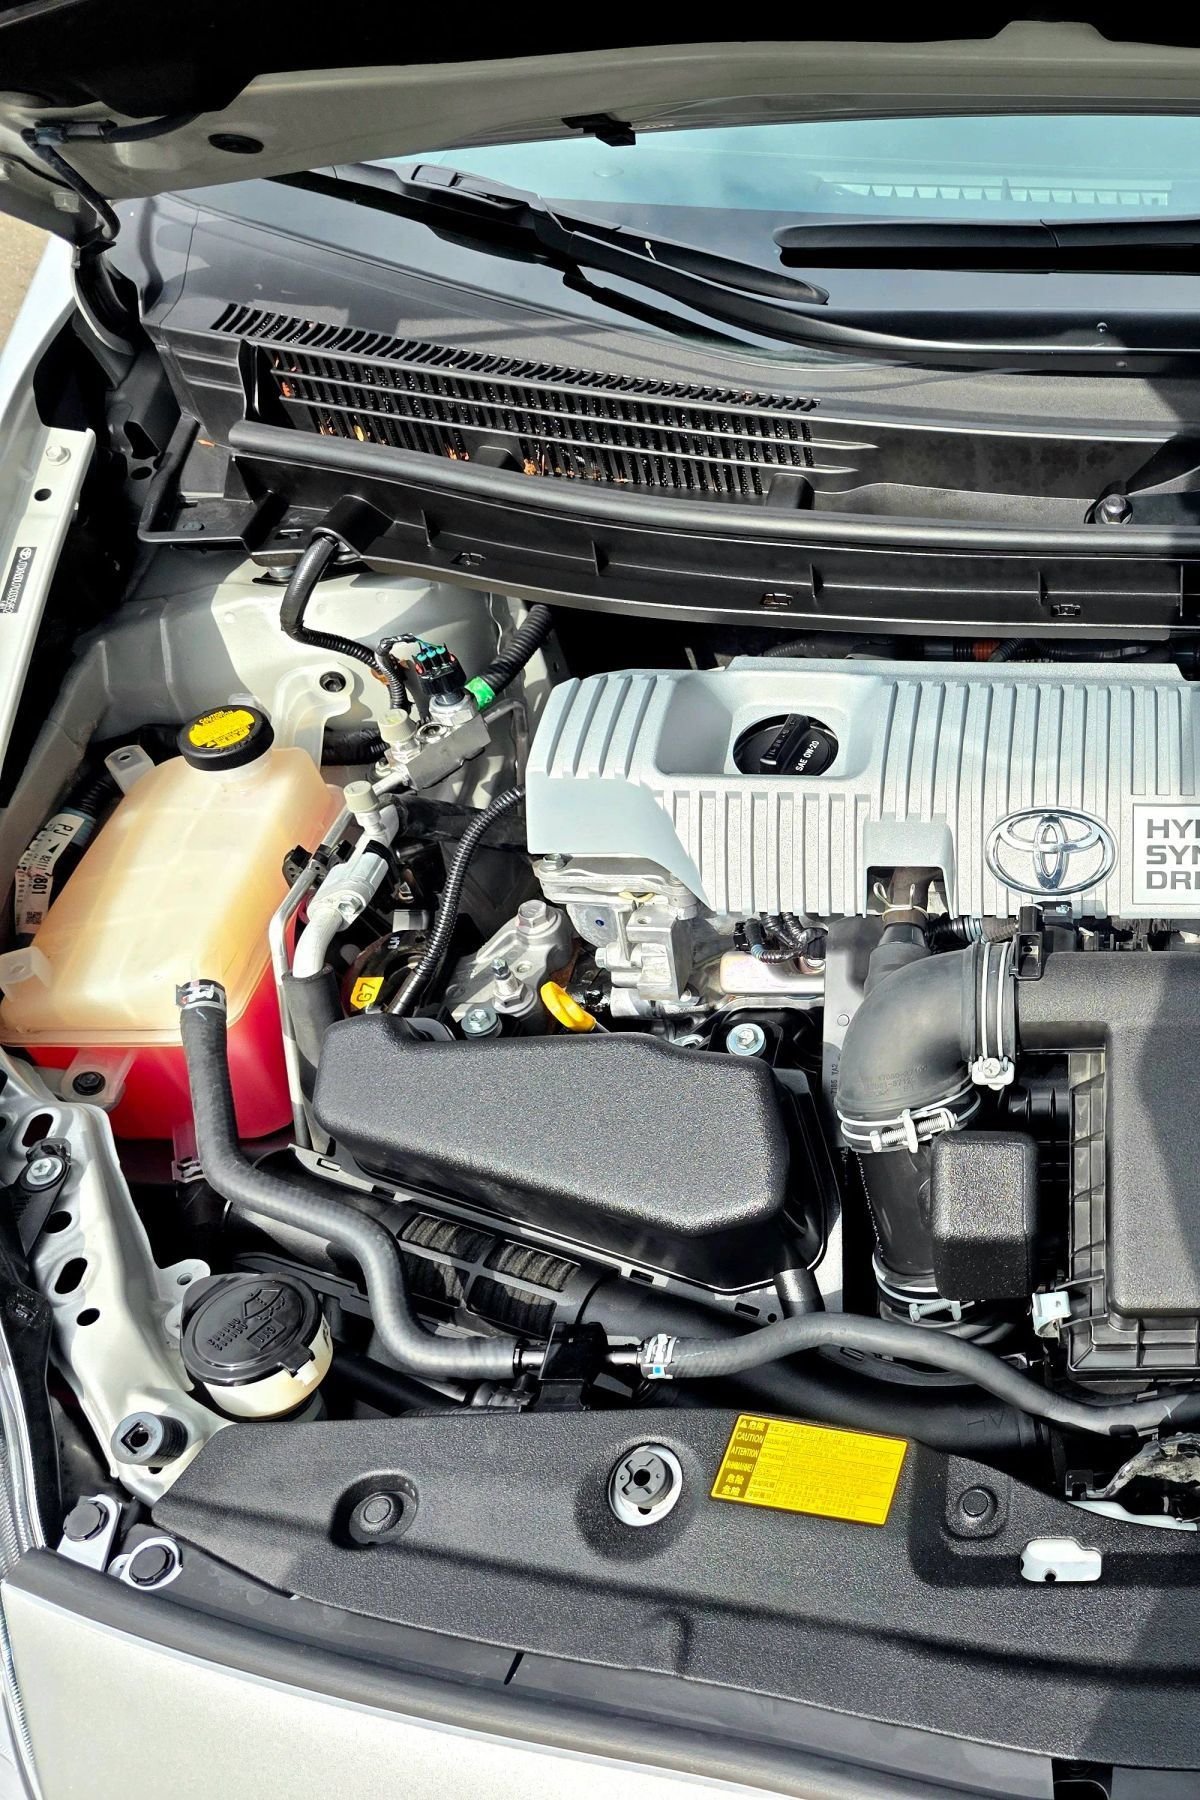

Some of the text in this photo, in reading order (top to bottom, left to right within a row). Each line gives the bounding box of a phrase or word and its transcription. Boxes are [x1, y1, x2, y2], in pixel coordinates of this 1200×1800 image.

[795, 758, 808, 772] SAE
[53, 823, 74, 836] PJ
[356, 982, 376, 1002] G7
[736, 1432, 764, 1444] CAUTION
[730, 1446, 760, 1458] ATTENTION
